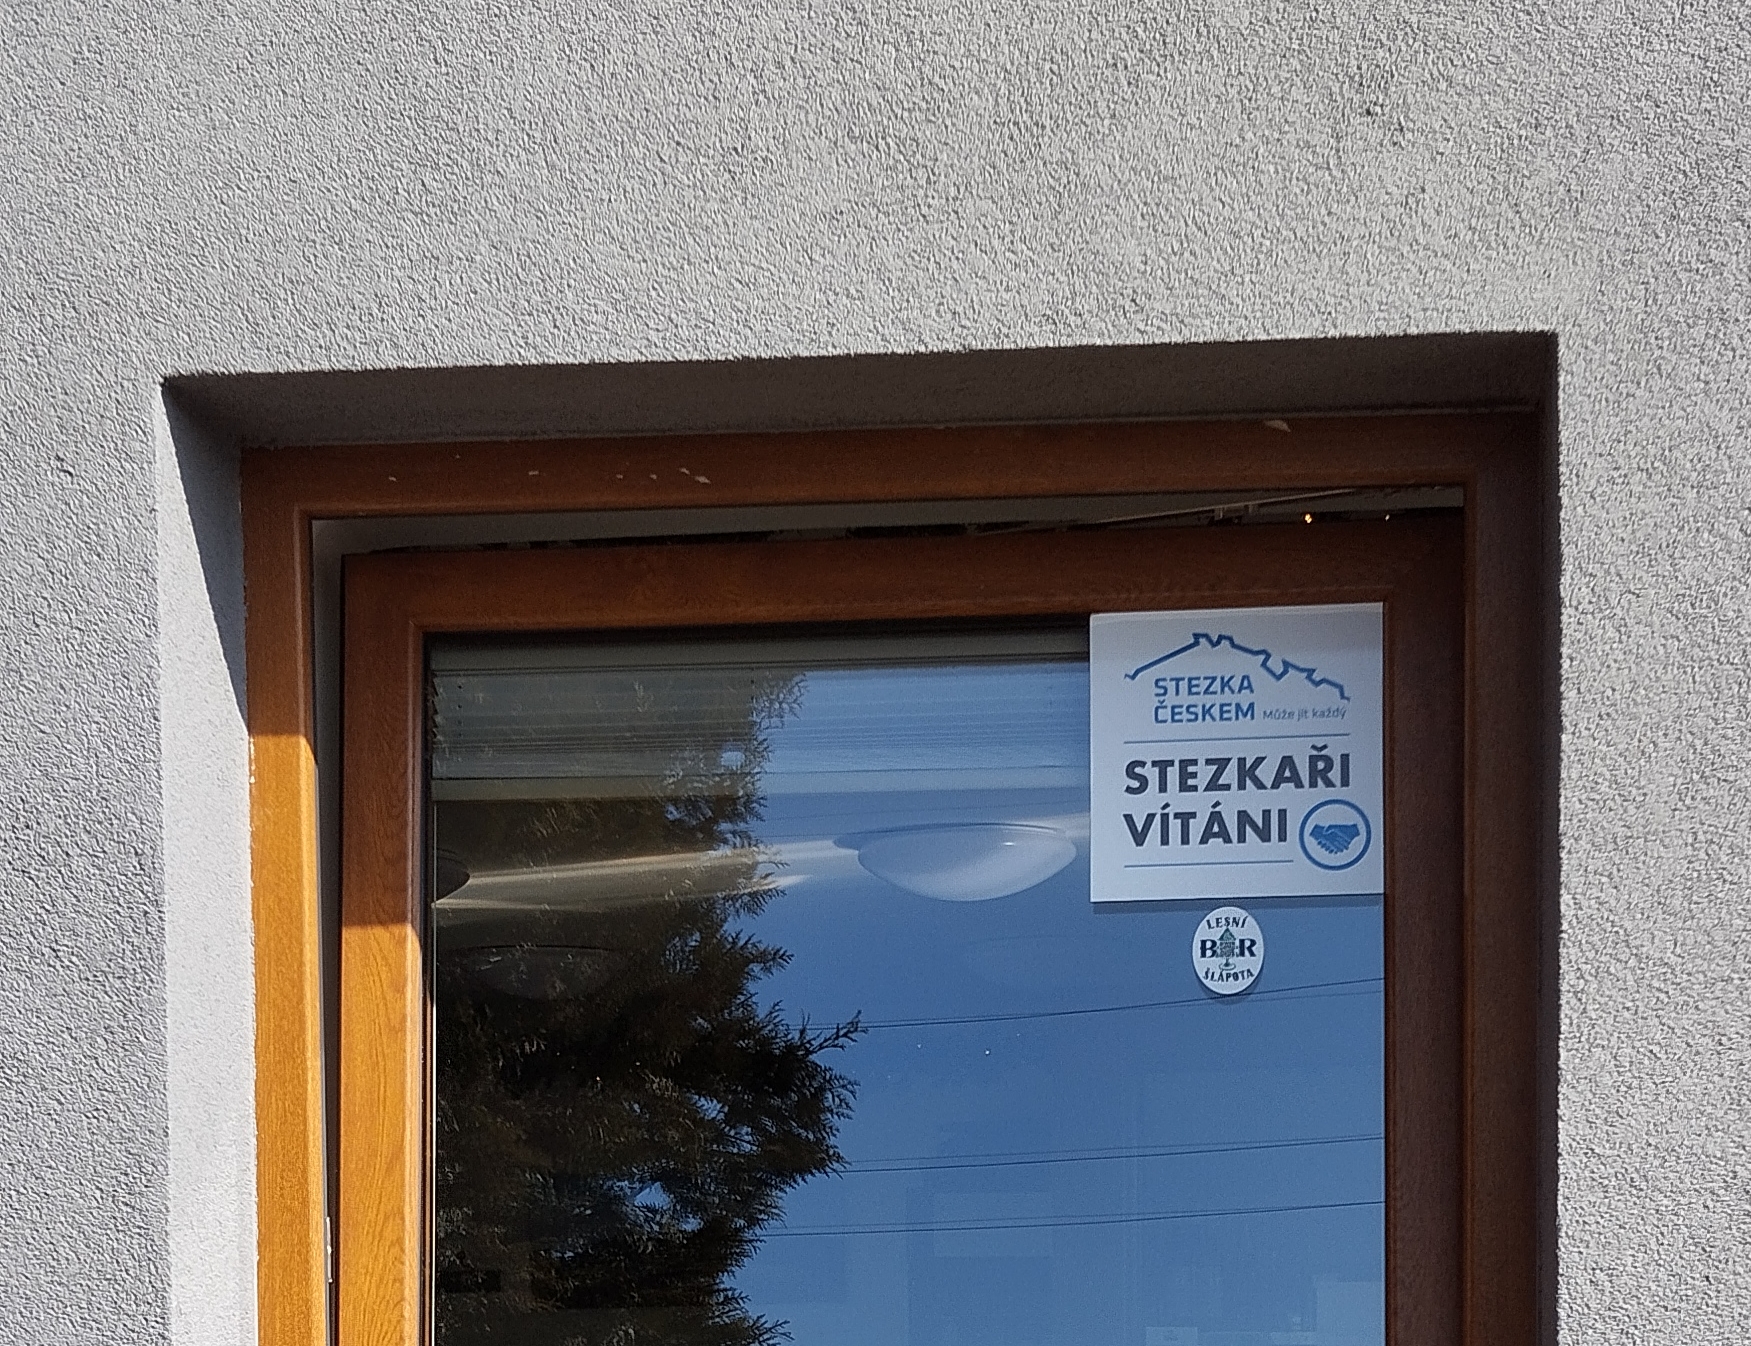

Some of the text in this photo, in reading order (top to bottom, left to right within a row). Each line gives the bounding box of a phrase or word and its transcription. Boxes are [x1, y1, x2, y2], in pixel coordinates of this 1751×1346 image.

[1154, 674, 1254, 697] STEZKA
[1154, 699, 1255, 724] ČESKEM
[1312, 705, 1347, 720] každý
[1124, 743, 1350, 796] STEZKAŘI
[1122, 800, 1288, 847] VÍTÁNI
[1206, 915, 1249, 930] LESNÍ
[1203, 967, 1255, 983] ŠLÁPOTA
